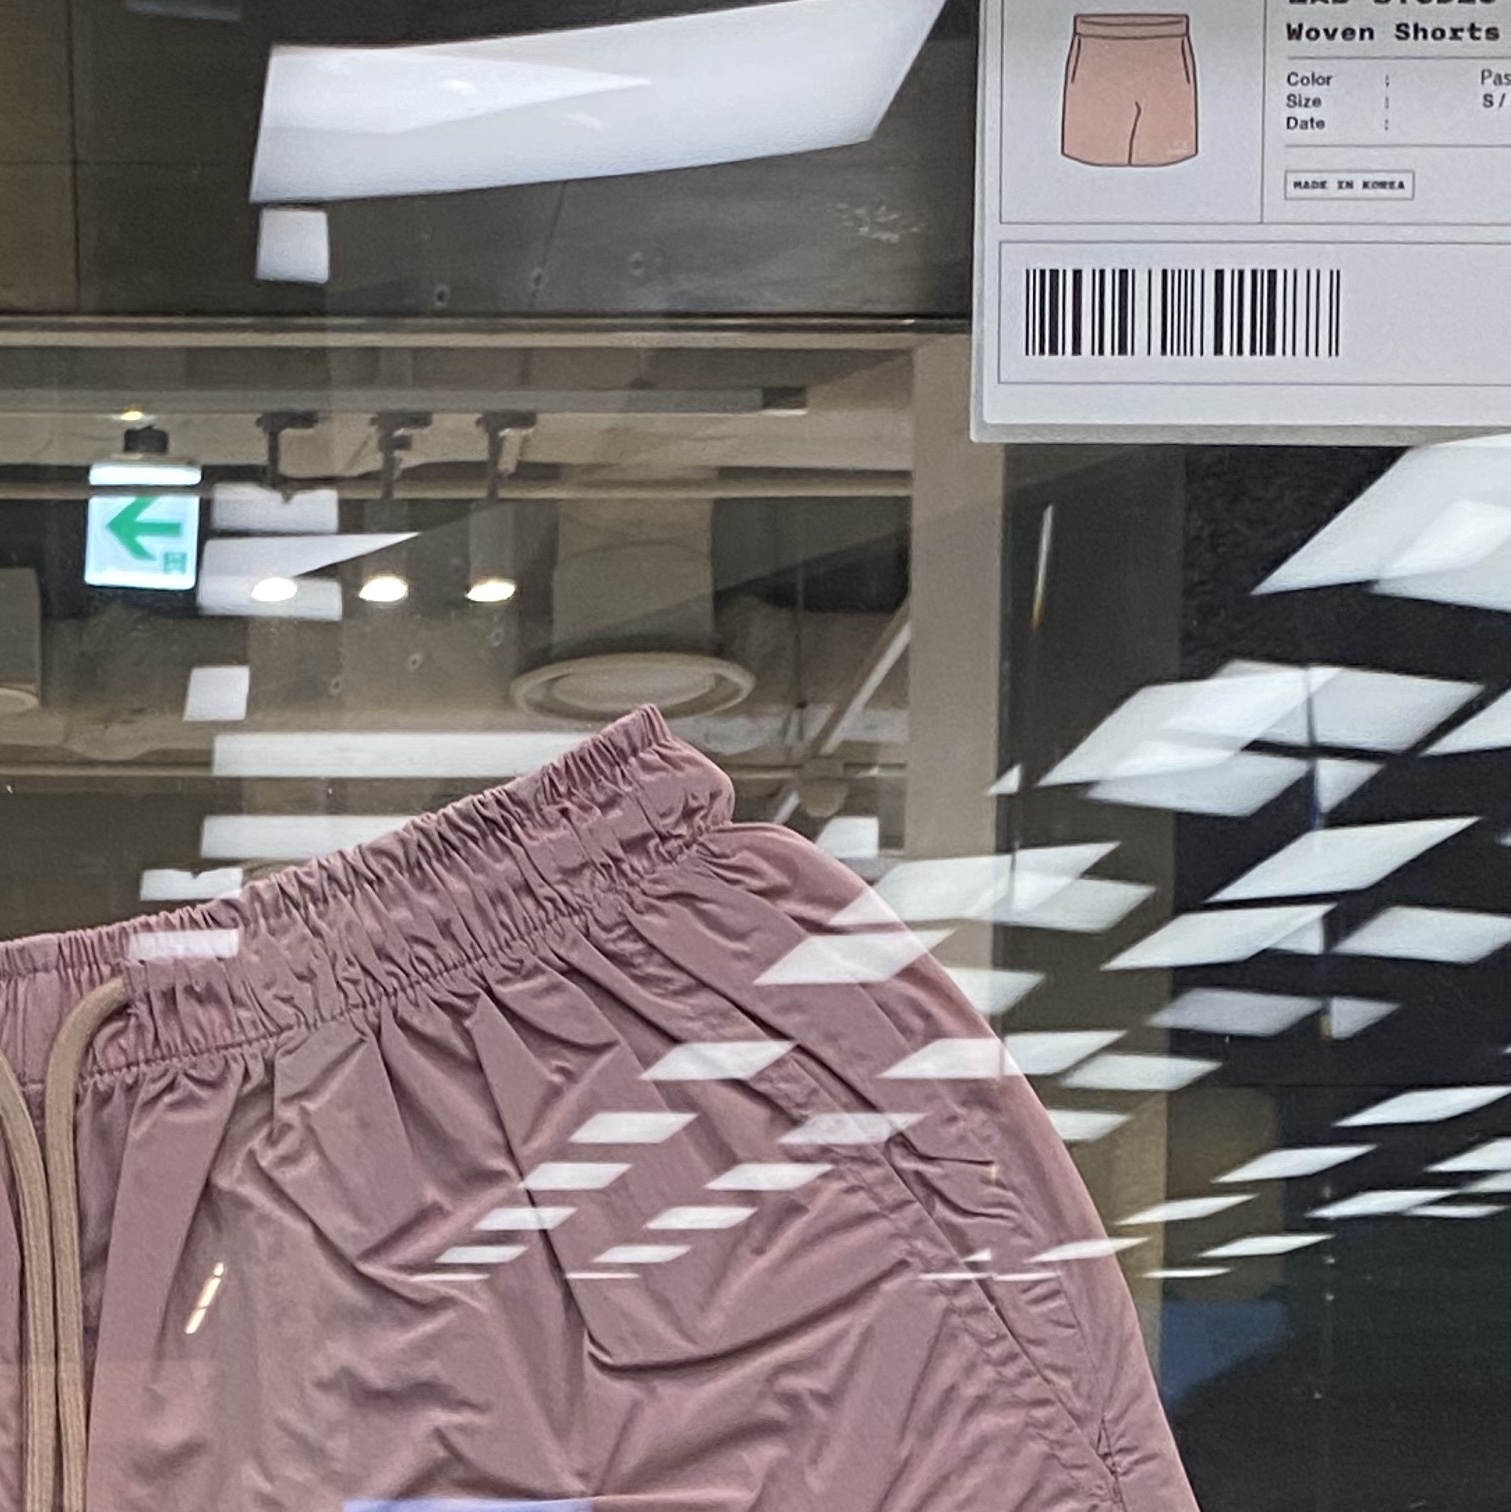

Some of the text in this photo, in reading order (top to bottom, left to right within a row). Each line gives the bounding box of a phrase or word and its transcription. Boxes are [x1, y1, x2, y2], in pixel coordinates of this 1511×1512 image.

[1285, 22, 1501, 41] Woven Shorts
[1286, 71, 1333, 87] Color
[1285, 93, 1323, 108] Size
[1285, 116, 1326, 131] Date
[1293, 180, 1405, 190] MADE IN KOREA
